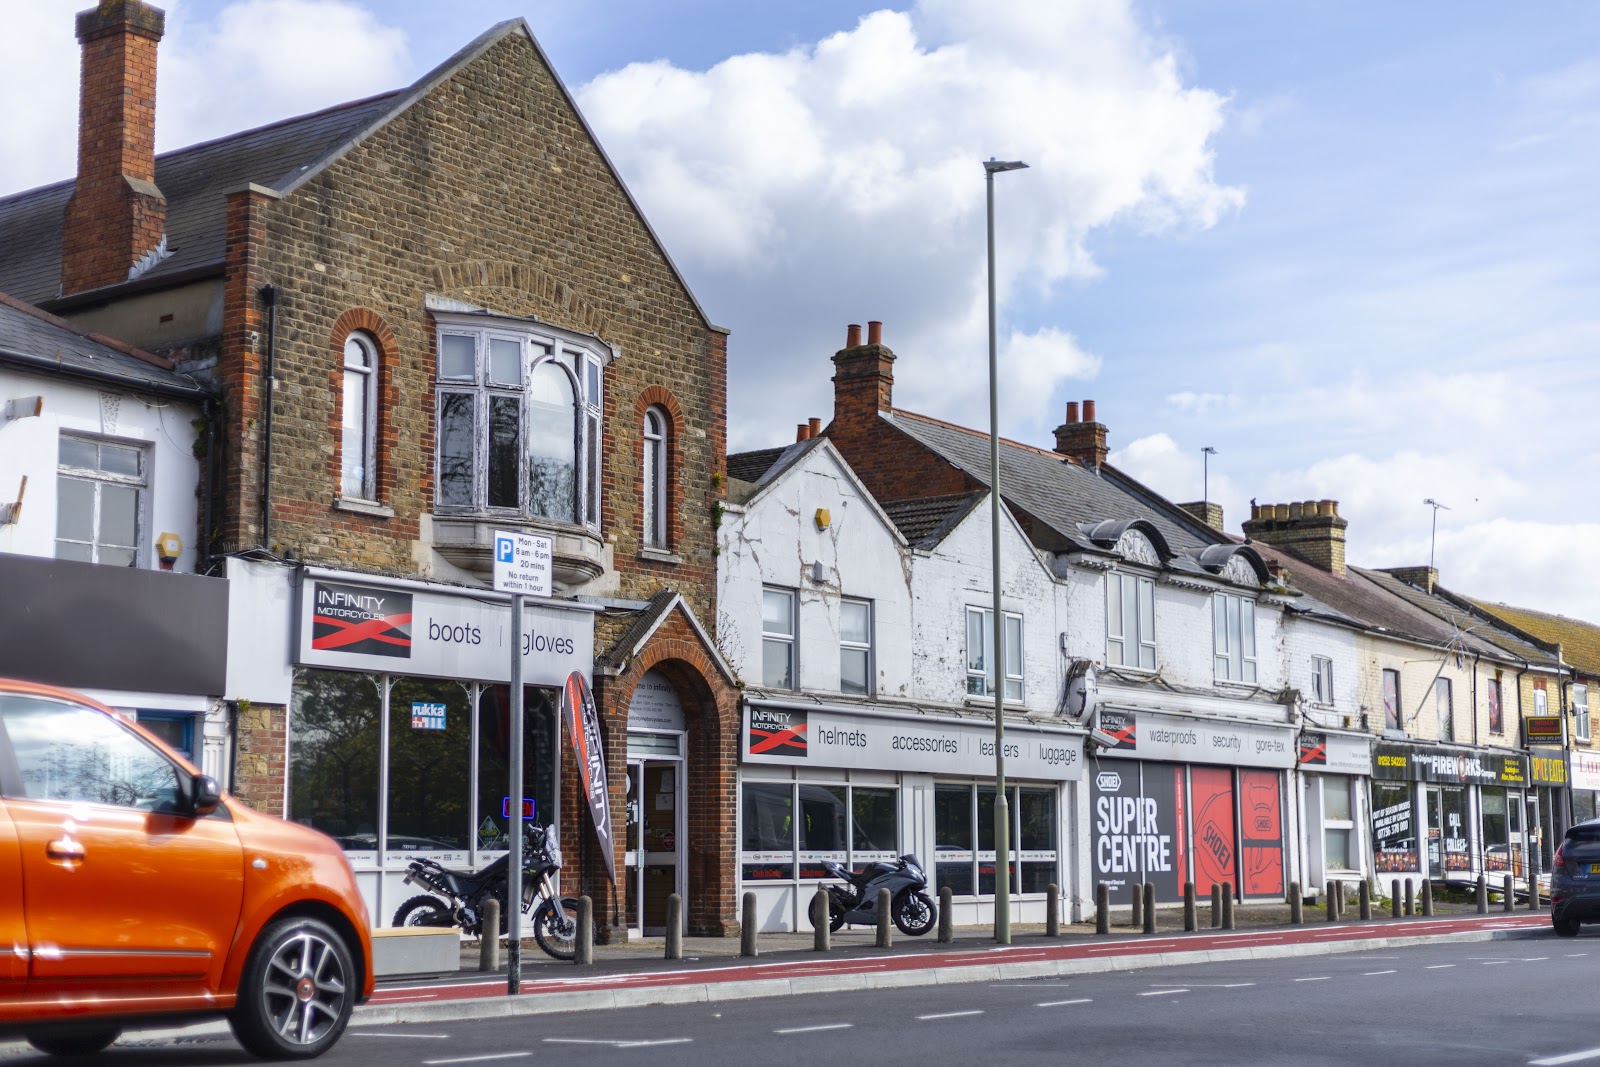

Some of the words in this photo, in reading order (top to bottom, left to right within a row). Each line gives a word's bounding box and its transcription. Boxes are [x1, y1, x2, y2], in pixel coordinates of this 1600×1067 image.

[500, 540, 512, 560] P
[518, 538, 532, 546] Mon
[536, 540, 547, 548] Sat
[521, 560, 529, 568] 20
[508, 571, 517, 579] No
[503, 581, 522, 589] within
[318, 590, 385, 610] INFINITY
[317, 606, 385, 621] MOTORCYCLES
[429, 618, 482, 645] boots
[522, 631, 574, 656] gloves
[654, 684, 671, 693] infinity
[413, 704, 444, 717] rukka
[752, 710, 792, 723] INFINITY
[752, 722, 792, 731] MOTORCYCLES
[1102, 715, 1126, 724] INFINITY
[818, 725, 867, 747] helmets
[892, 735, 958, 753] accessories
[979, 738, 1019, 757] leaers
[1039, 743, 1076, 765] luggage
[1149, 729, 1197, 747] waterproofs
[1212, 735, 1241, 752] security
[1256, 739, 1285, 754] gore-tex
[1419, 754, 1432, 764] Original
[1432, 754, 1480, 779] FIREWORKS
[1481, 770, 1496, 780] Company
[1532, 757, 1548, 781] SPICE
[1100, 776, 1118, 787] SHOEI
[504, 800, 533, 816] OEN
[1097, 796, 1158, 834] SUPER
[1380, 808, 1385, 818] OF
[1385, 804, 1398, 815] SEASON
[1399, 801, 1410, 811] ORDERS
[1375, 816, 1392, 828] AVAILABLE
[1397, 810, 1410, 821] CALLING
[1400, 820, 1408, 832] 000
[1449, 813, 1461, 826] CALL
[1097, 835, 1171, 873] CENTRE
[1203, 826, 1231, 870] SHOEI
